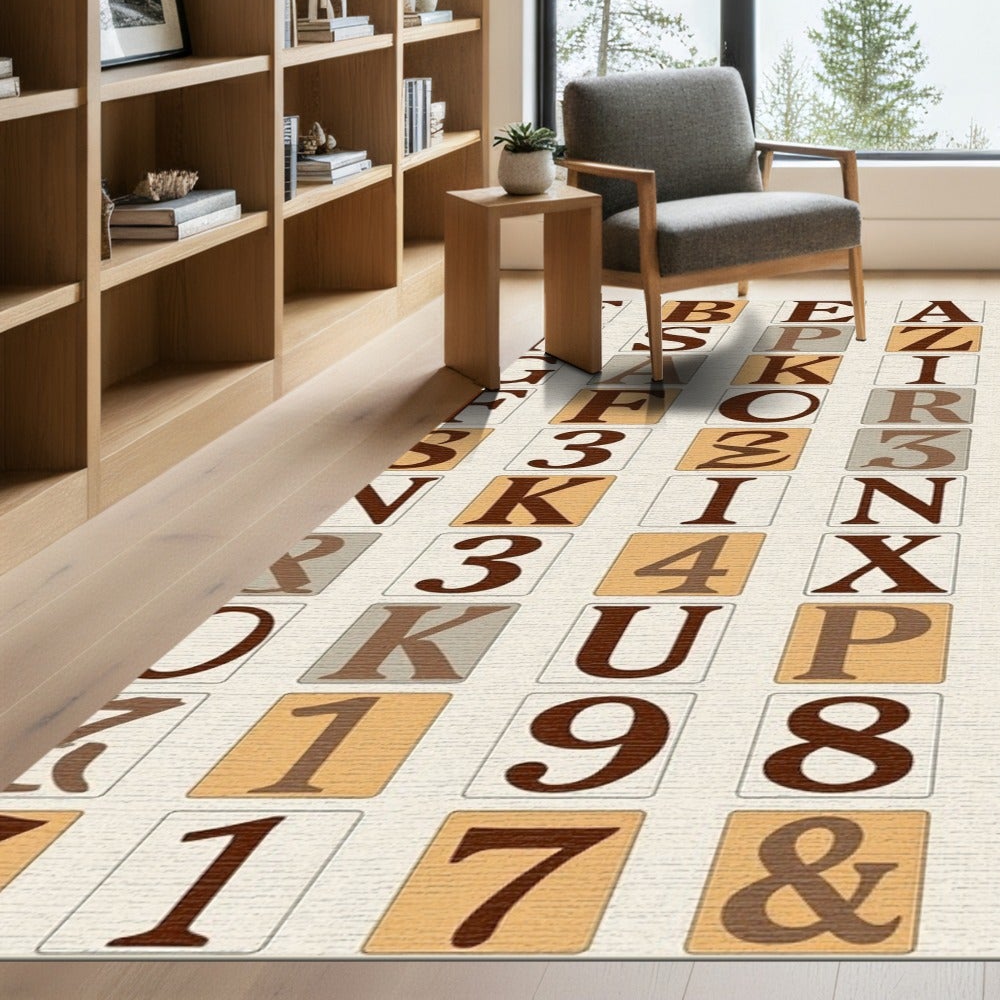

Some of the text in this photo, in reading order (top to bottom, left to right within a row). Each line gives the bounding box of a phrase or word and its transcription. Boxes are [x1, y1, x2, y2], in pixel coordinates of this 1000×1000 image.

[662, 301, 735, 322] B
[783, 301, 857, 322] E
[900, 301, 976, 322] A
[633, 327, 711, 351] S
[768, 327, 841, 352] P
[899, 327, 973, 351] Z
[749, 355, 840, 384] K
[905, 356, 950, 384] I
[560, 389, 665, 423] F
[717, 390, 820, 423] O
[877, 390, 970, 424] R
[527, 430, 626, 469] 3
[860, 430, 961, 469] 3
[463, 477, 605, 525] K
[681, 478, 757, 524] I
[842, 478, 955, 524] N
[415, 535, 542, 593] 3
[634, 536, 729, 593] 4
[814, 535, 945, 593] X
[317, 606, 511, 679] K
[576, 606, 722, 679] U
[793, 606, 931, 679] P
[247, 697, 380, 793] 1
[505, 696, 670, 793] 9
[763, 696, 914, 793] 8
[106, 816, 286, 947] 1
[450, 827, 620, 948] 7
[721, 816, 901, 944] &
